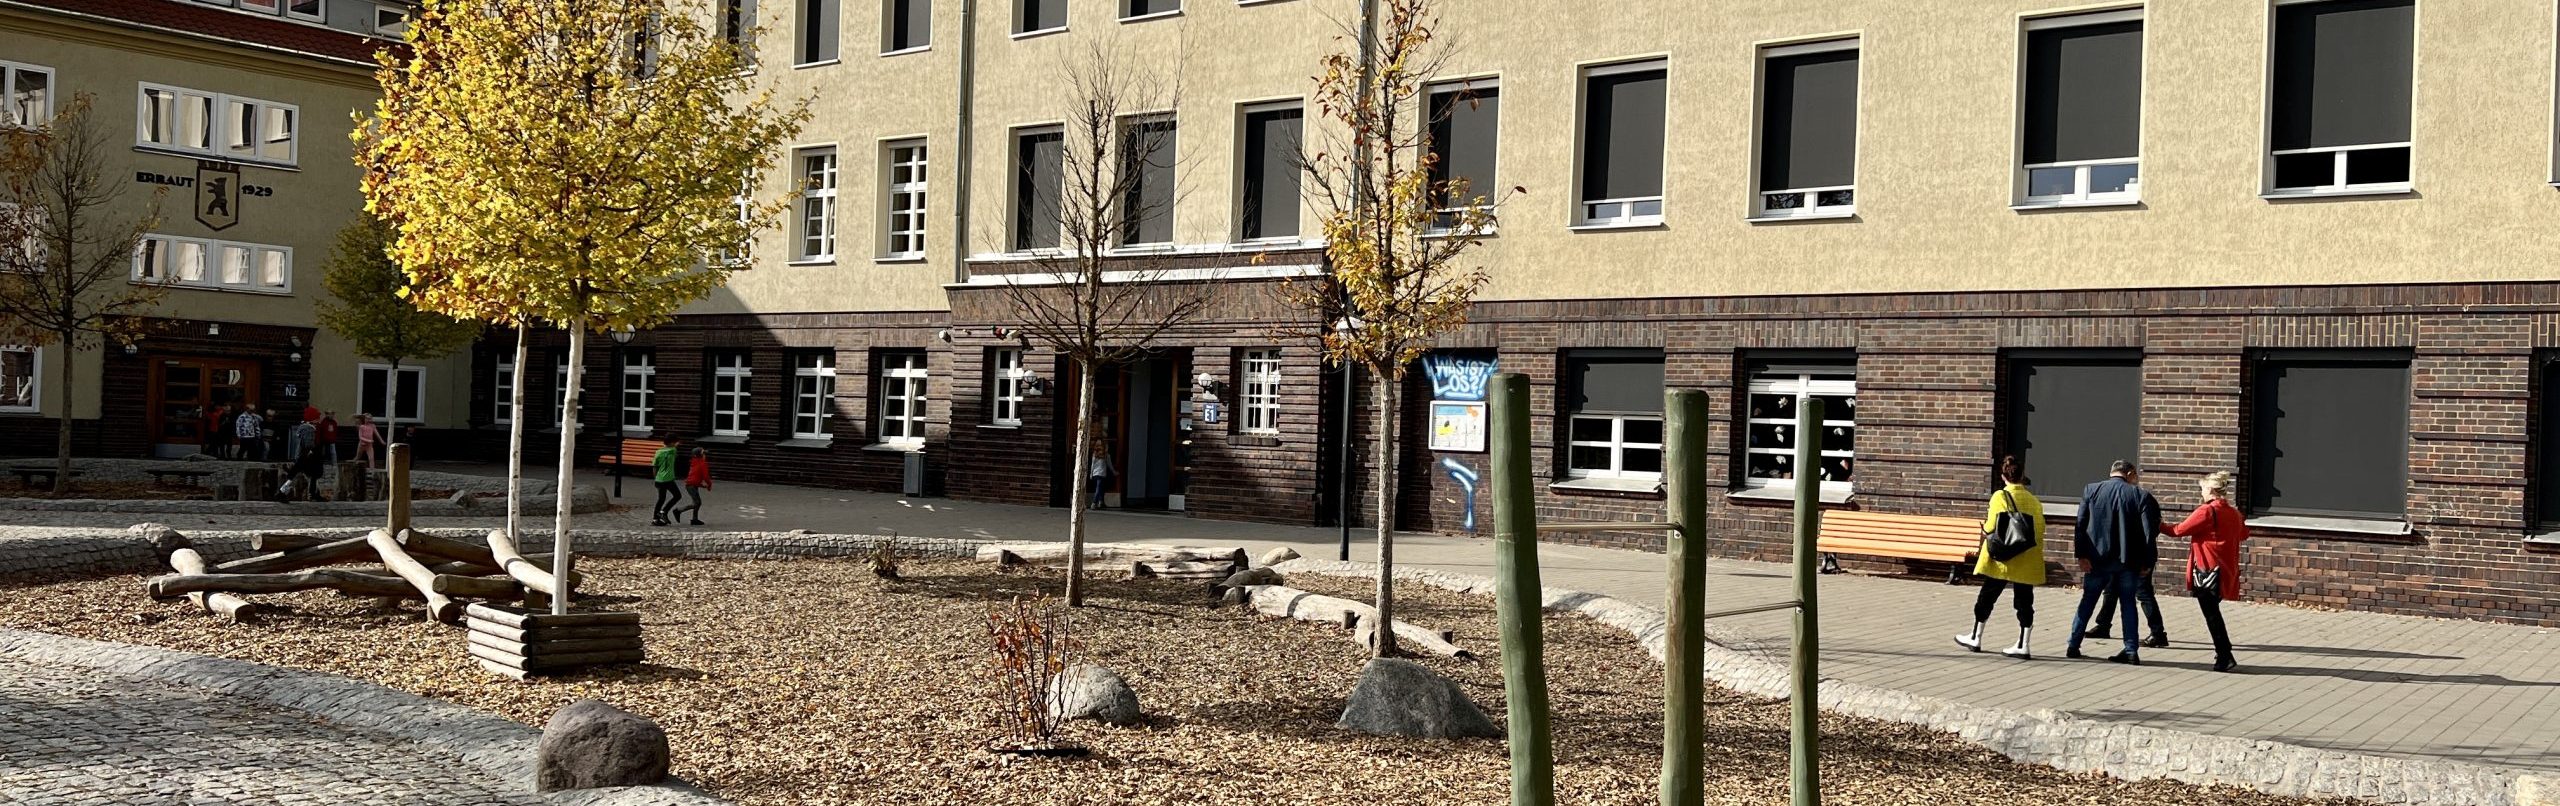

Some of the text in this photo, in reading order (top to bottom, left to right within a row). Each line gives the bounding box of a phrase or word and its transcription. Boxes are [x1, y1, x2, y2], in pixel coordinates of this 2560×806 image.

[136, 171, 274, 197] ERBAUT 1929
[285, 386, 297, 397] N2
[1204, 409, 1215, 422] E1
